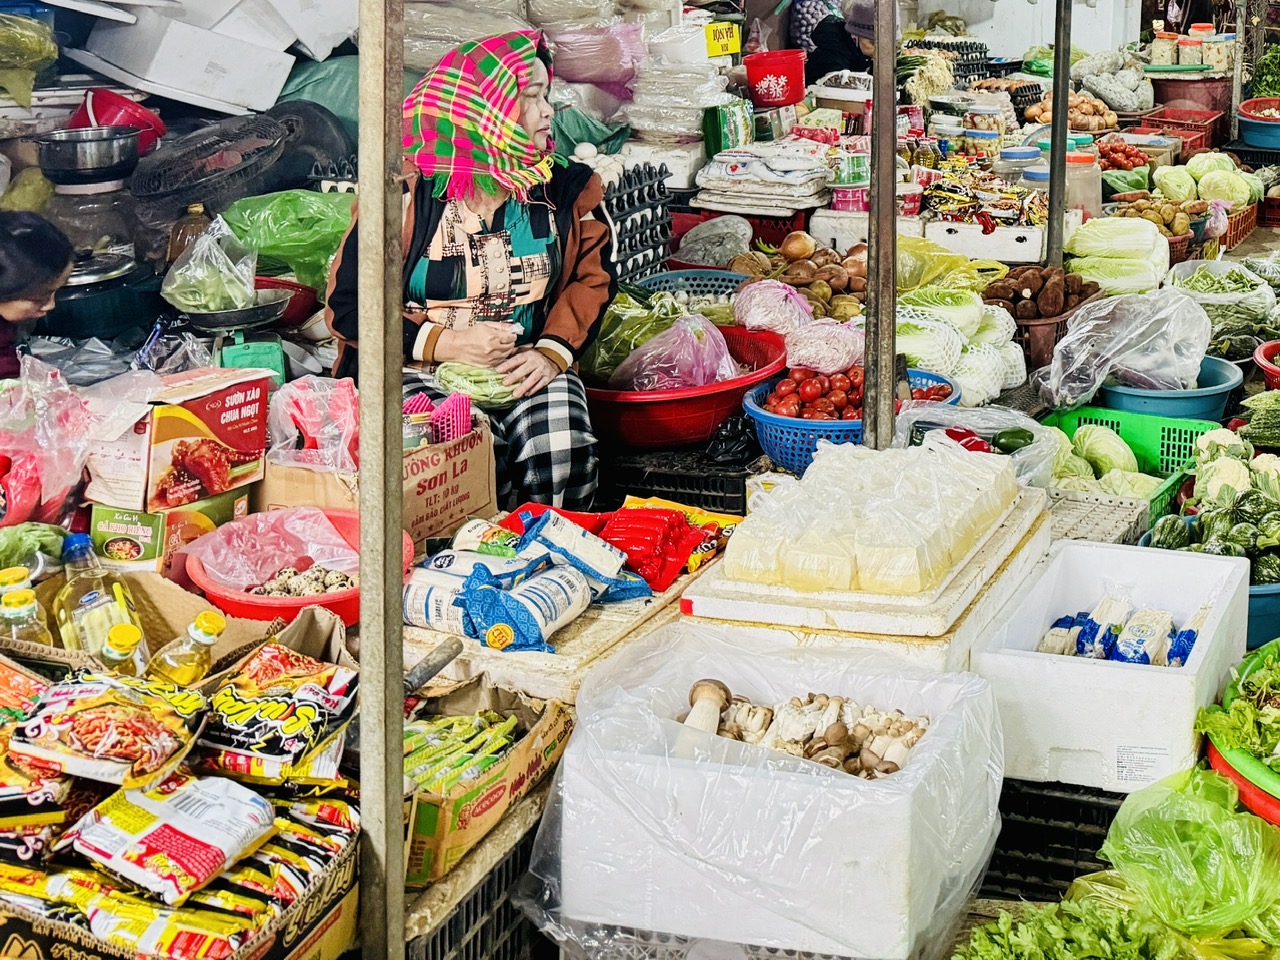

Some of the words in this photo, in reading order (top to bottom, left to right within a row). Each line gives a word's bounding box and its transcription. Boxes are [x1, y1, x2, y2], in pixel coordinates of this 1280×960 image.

[220, 408, 240, 425] CHUA
[240, 402, 260, 418] NGỌT
[402, 452, 441, 481] ƯỜNG
[416, 471, 448, 496] Sơn
[452, 458, 468, 479] La
